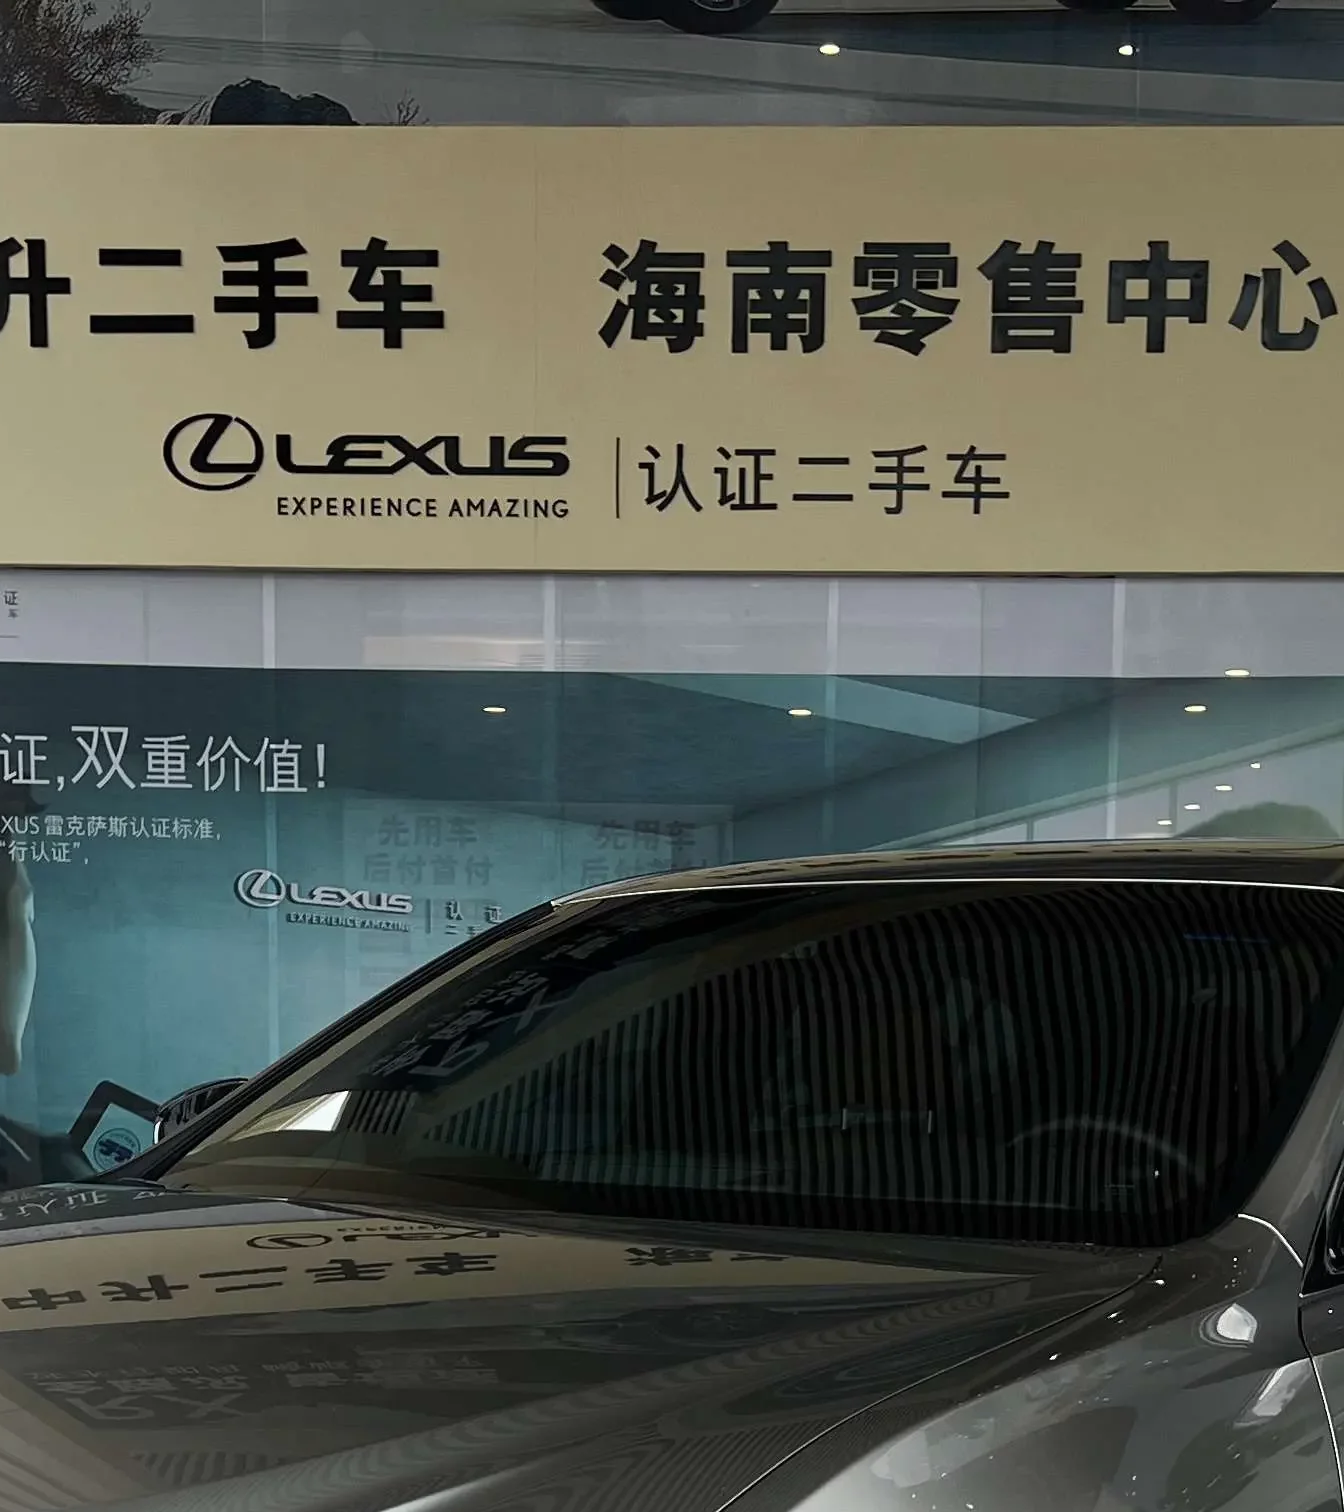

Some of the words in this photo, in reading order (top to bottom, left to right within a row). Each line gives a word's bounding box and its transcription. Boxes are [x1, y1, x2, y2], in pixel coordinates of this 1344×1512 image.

[597, 239, 1339, 357] 海南零售中心
[275, 432, 571, 476] LEXUS
[637, 444, 1012, 516] 认证二手车
[276, 496, 438, 519] EXPERIENCE
[448, 497, 570, 520] AMAZING
[378, 814, 478, 849] 先用车
[288, 882, 414, 915] LEXUS
[444, 899, 504, 925] 认证
[286, 911, 360, 928] EXPERIENCE
